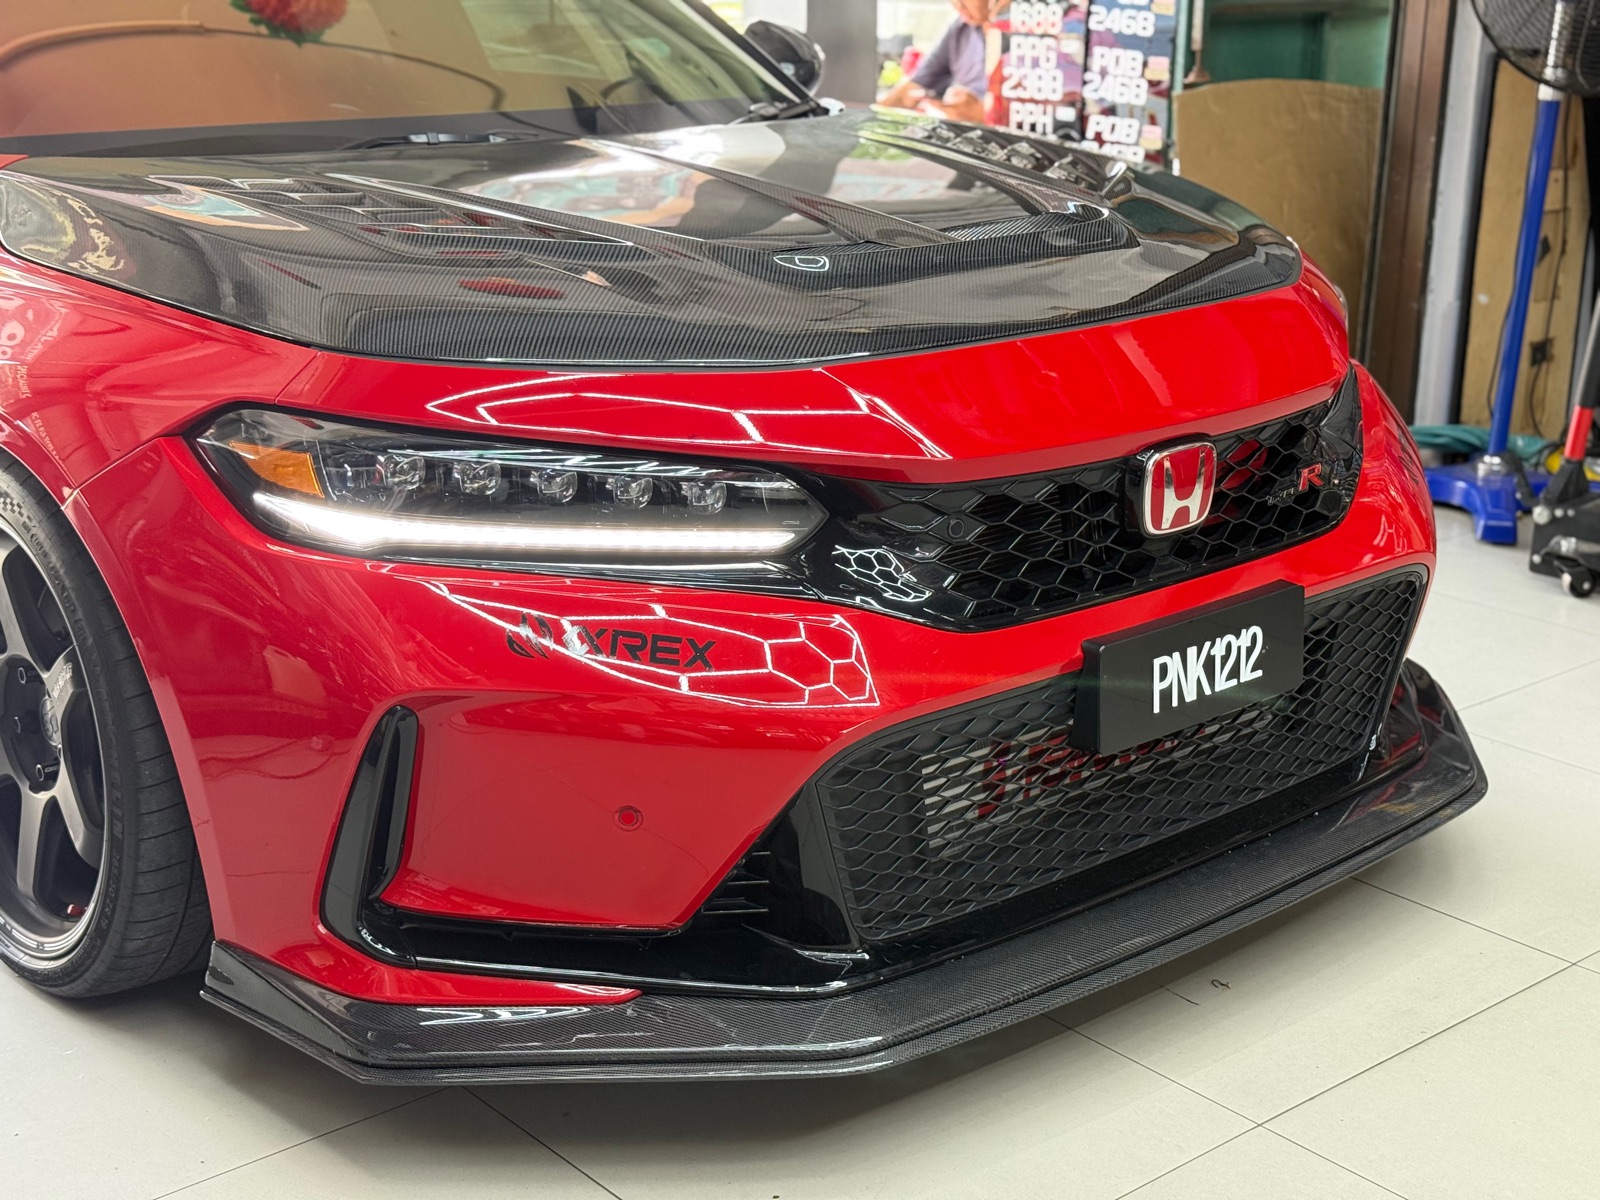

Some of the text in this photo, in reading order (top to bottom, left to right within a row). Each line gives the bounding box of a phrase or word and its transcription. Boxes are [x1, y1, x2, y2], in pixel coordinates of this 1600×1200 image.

[1088, 5, 1155, 37] 2468
[1010, 35, 1058, 69] PPG
[1002, 66, 1064, 101] 2388
[1082, 72, 1148, 106] 2468
[1010, 101, 1054, 134] PPH
[1152, 625, 1263, 714] PNK1212
